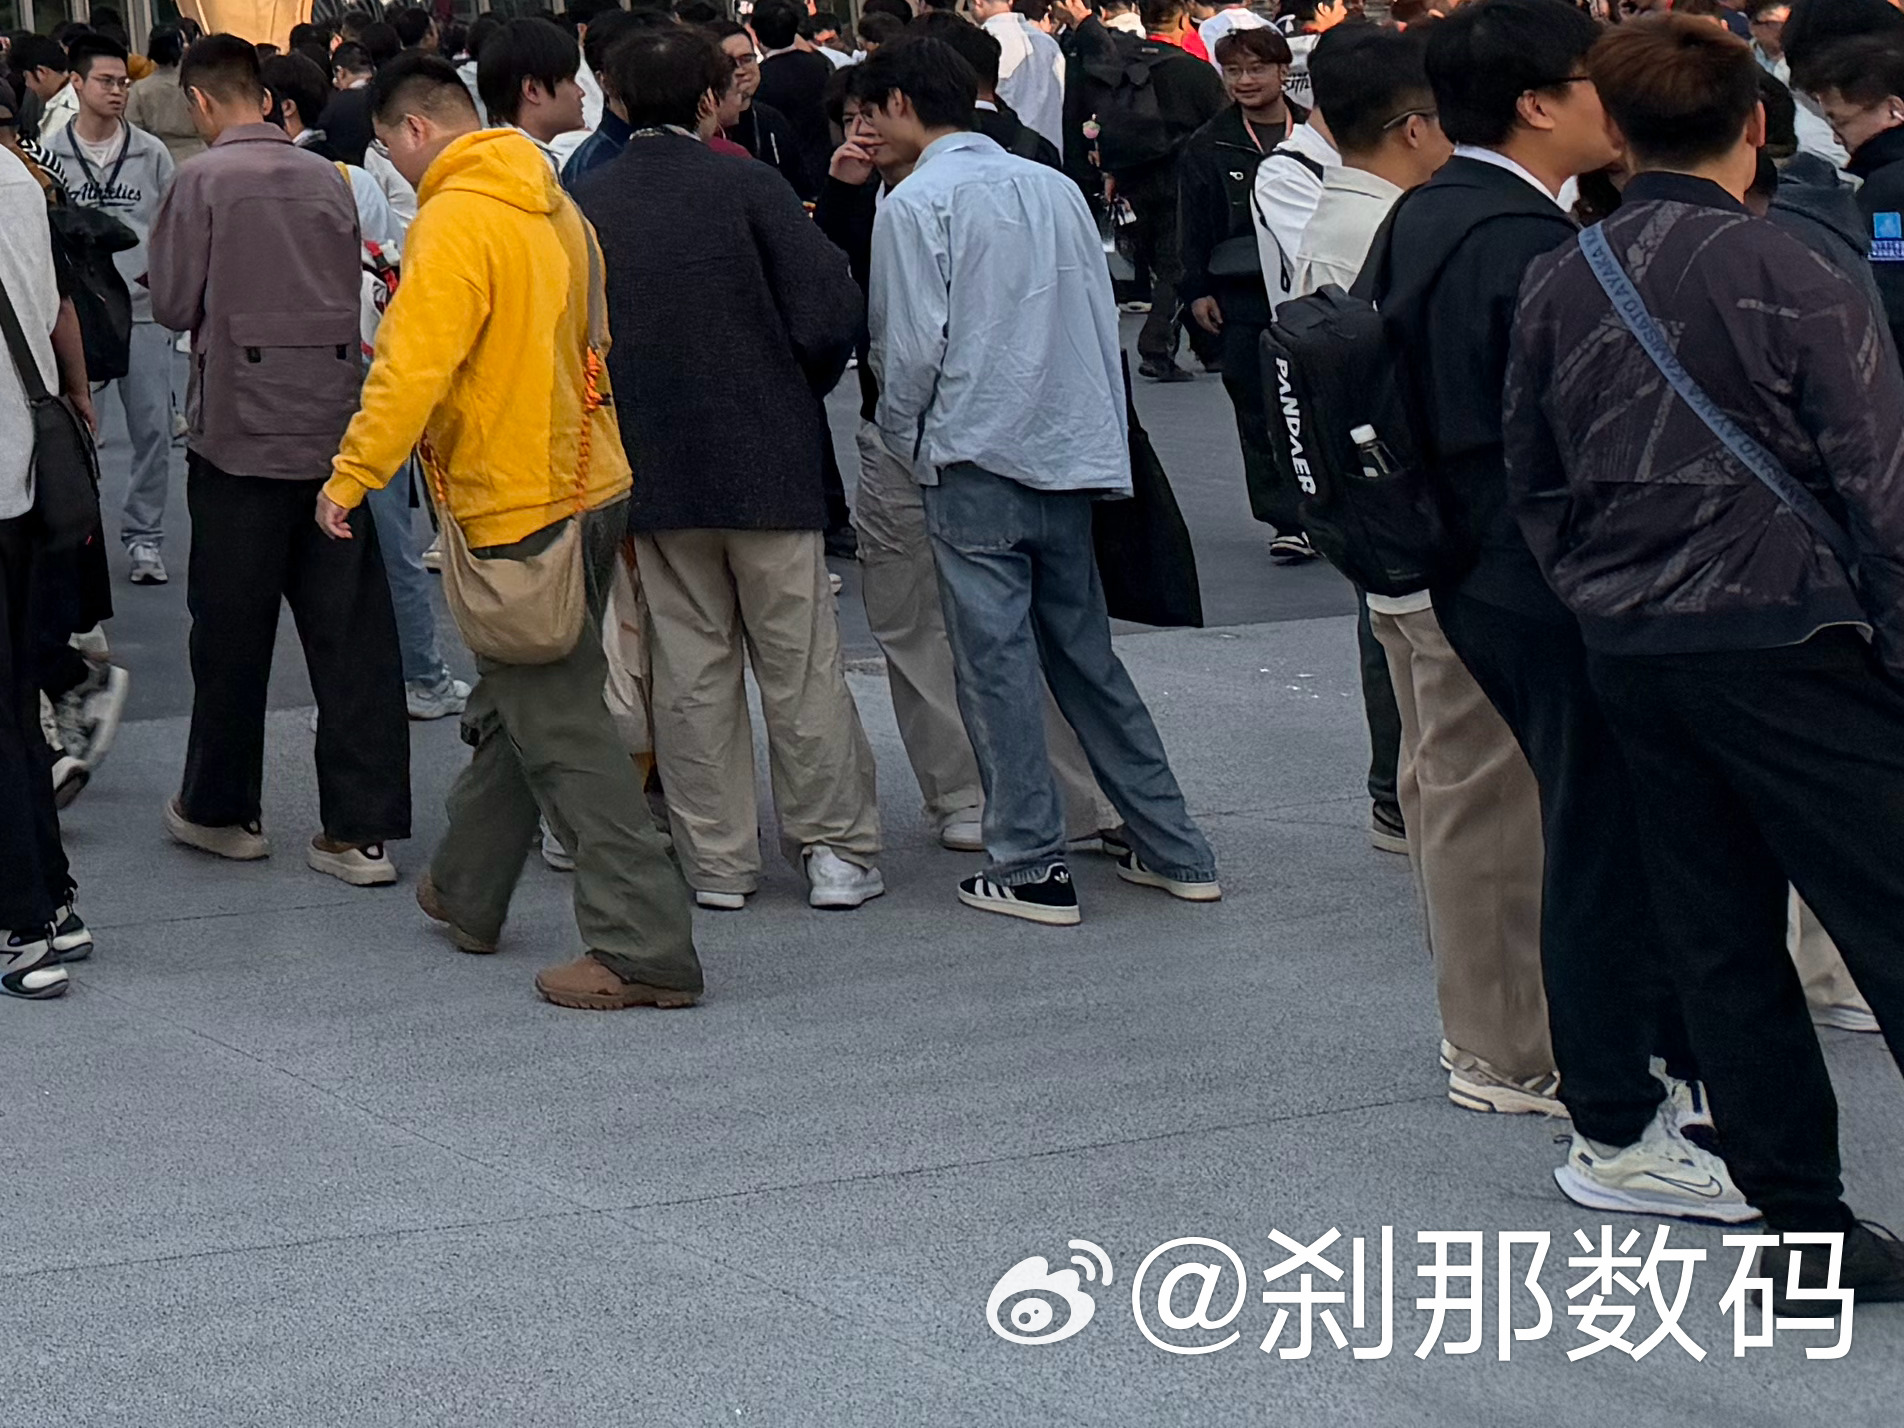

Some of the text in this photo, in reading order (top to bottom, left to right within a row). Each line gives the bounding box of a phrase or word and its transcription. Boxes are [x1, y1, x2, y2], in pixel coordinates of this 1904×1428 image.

[1591, 245, 1628, 297] AYAKA
[1622, 298, 1687, 384] KAMISATO
[1275, 357, 1317, 495] PANDAER
